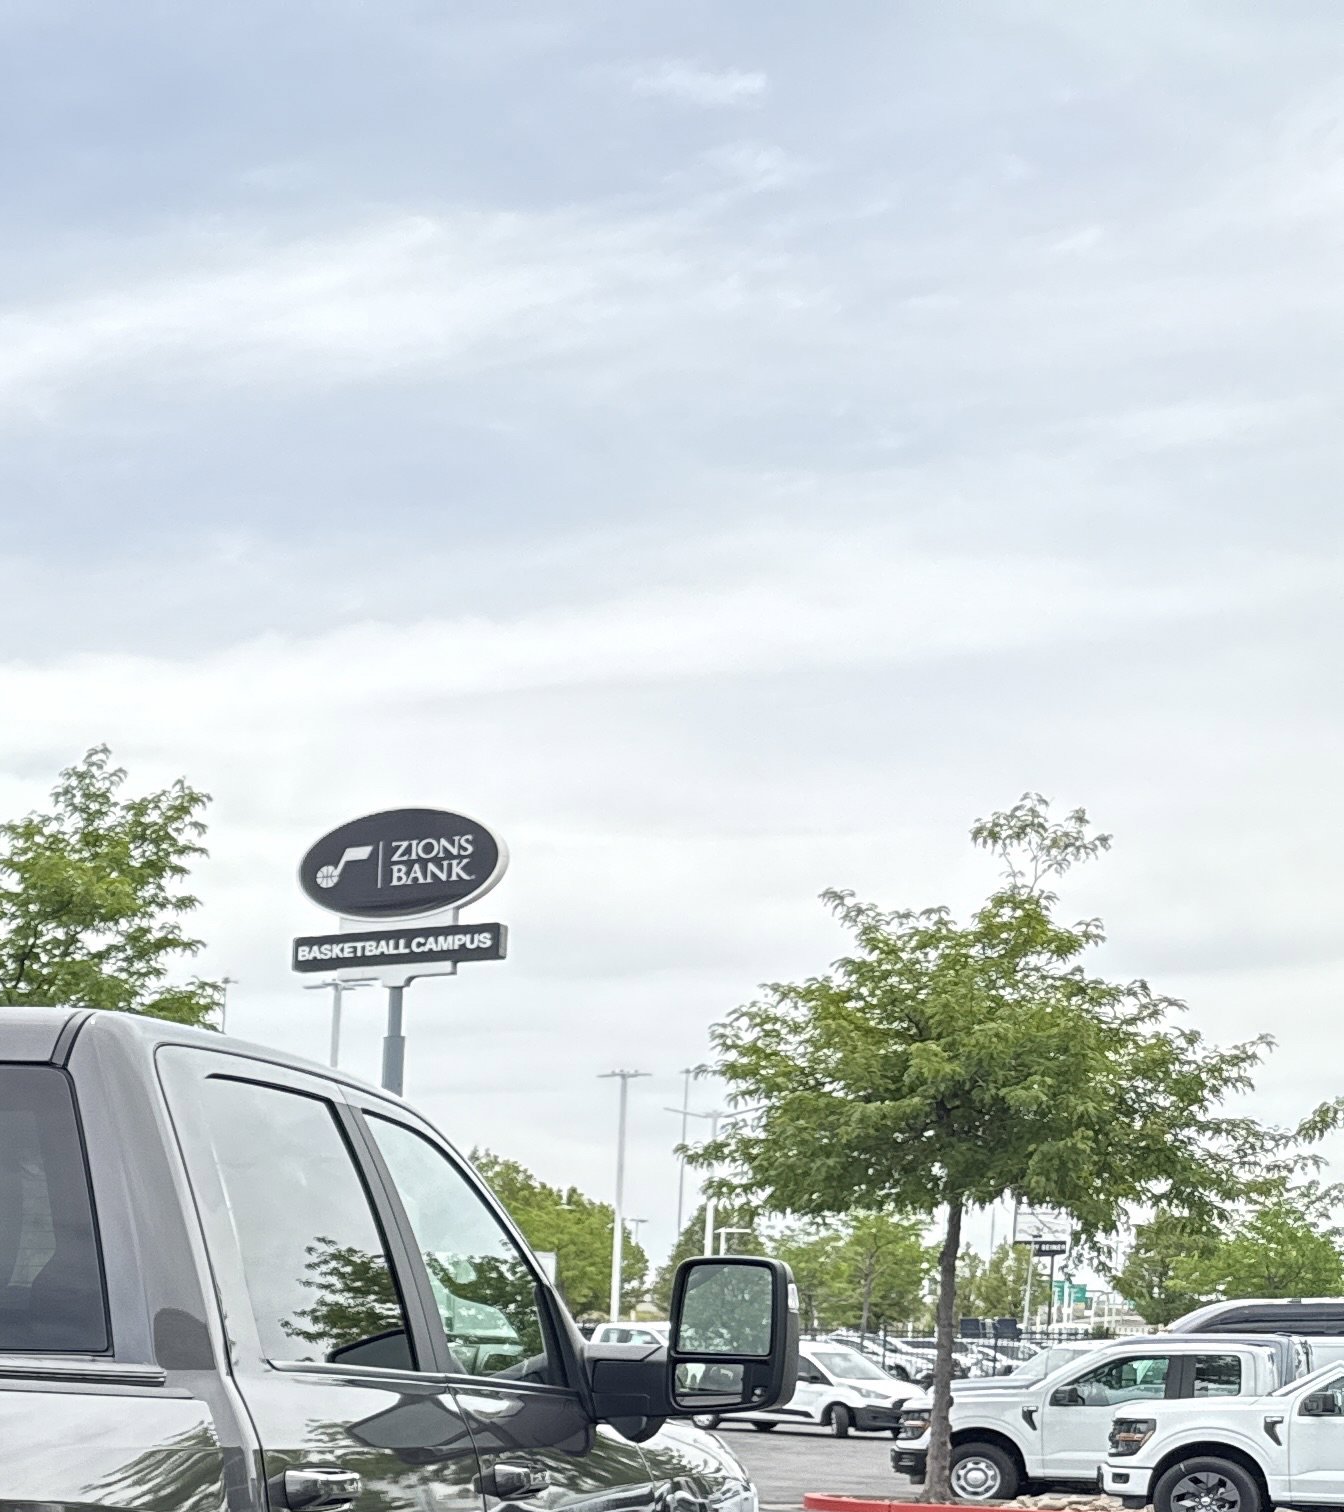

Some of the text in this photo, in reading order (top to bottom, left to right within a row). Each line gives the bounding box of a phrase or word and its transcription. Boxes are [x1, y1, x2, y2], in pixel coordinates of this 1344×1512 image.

[390, 833, 475, 862] ZIONS
[389, 858, 473, 887] BANK
[297, 932, 493, 962] BASKETBALL CAMPUS
